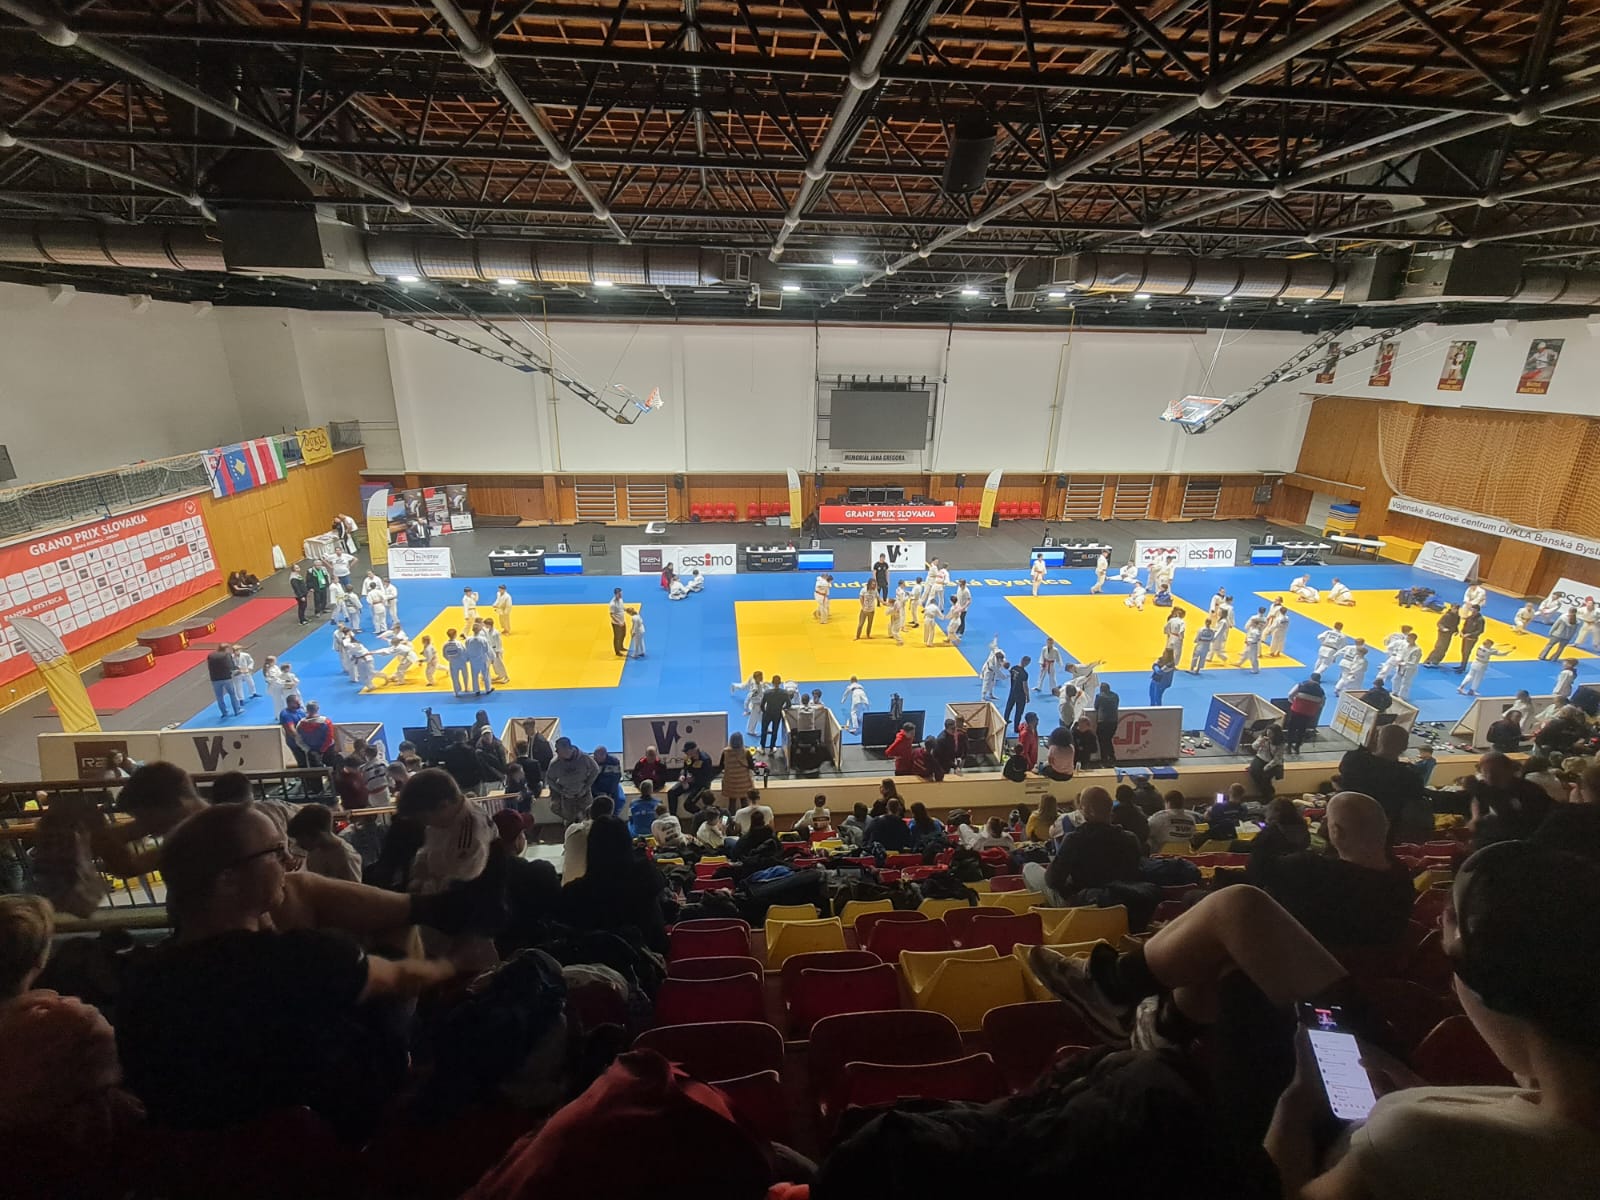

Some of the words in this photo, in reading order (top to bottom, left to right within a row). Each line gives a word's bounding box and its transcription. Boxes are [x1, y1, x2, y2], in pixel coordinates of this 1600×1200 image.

[845, 510, 874, 518] GRAND
[876, 510, 896, 518] PRIX
[897, 510, 935, 518] SLOVAKIA
[29, 535, 73, 556] GRAND
[74, 528, 100, 543] PRIX
[101, 515, 148, 535] SLOVAKIA
[1461, 517, 1497, 531] centrum
[1498, 525, 1531, 540] DUKLA
[1575, 542, 1600, 556] Byst
[682, 553, 733, 566] essimo
[1188, 547, 1232, 559] essimo
